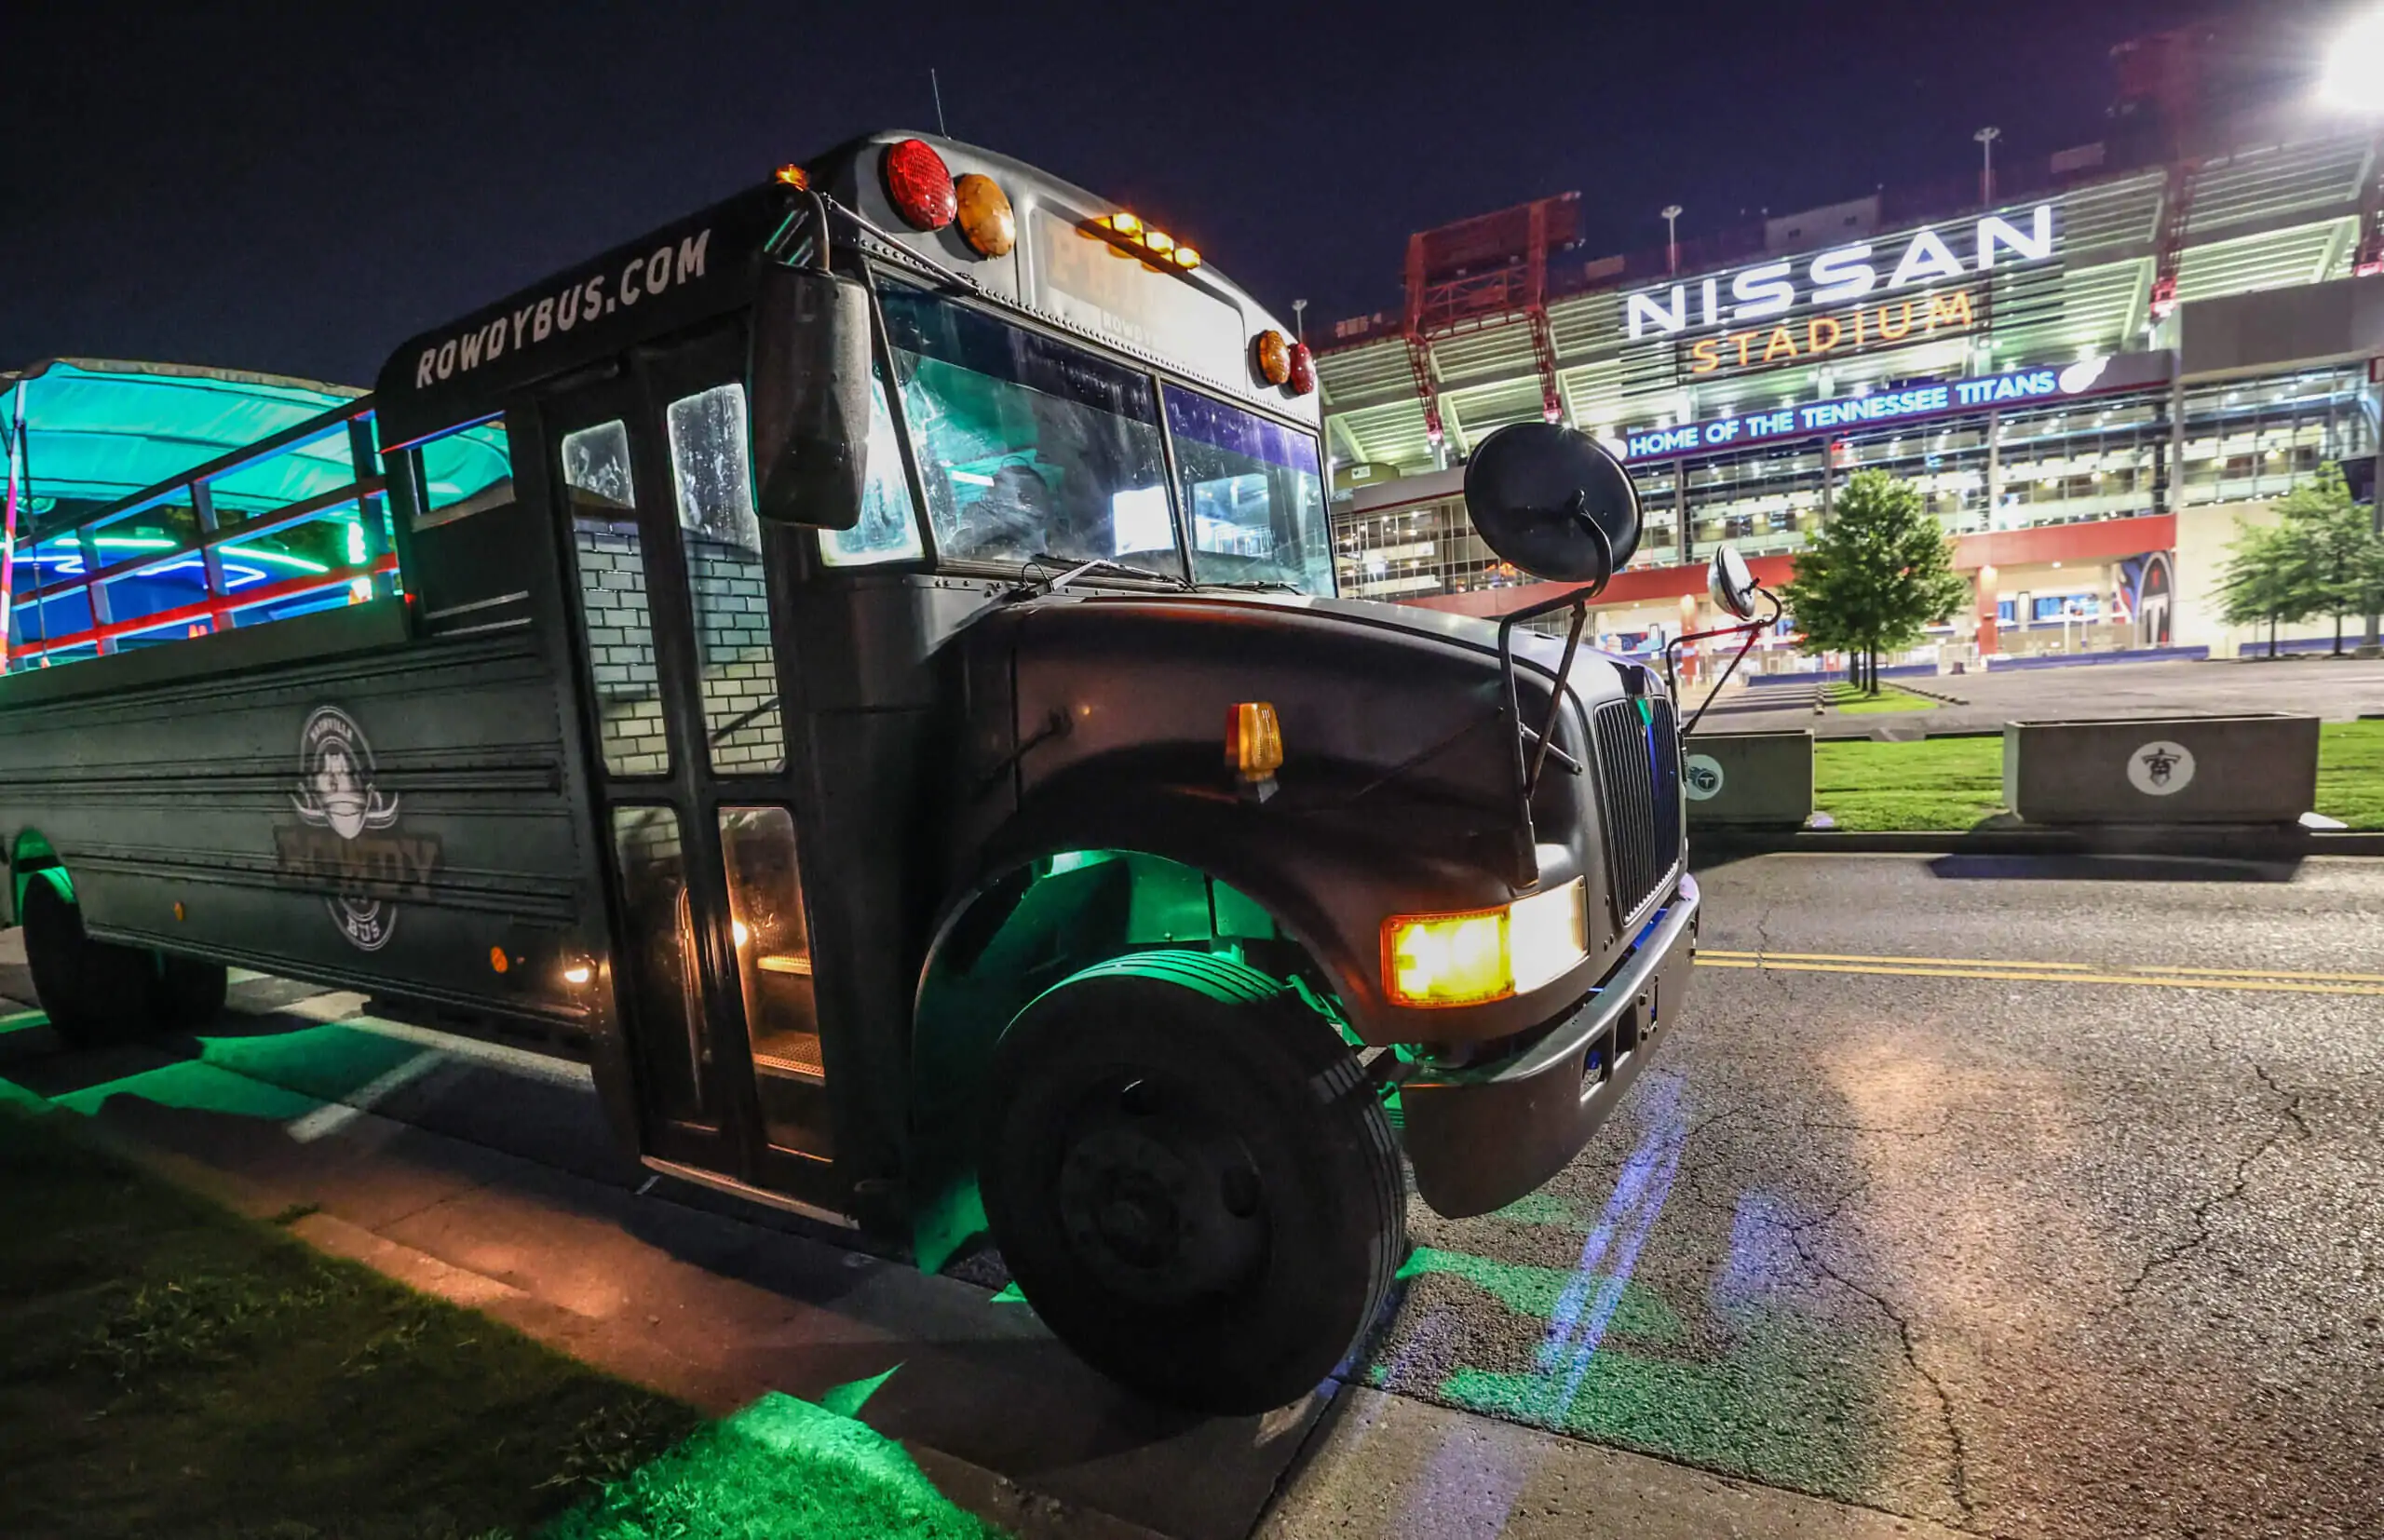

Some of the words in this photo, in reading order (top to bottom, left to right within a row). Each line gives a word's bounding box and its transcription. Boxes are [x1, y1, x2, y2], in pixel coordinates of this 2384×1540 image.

[415, 229, 711, 389] ROWDYBUS.COM
[1629, 205, 2052, 339] NISSAN
[1691, 290, 1972, 372] STADIUM
[1629, 426, 1700, 457] HOME
[1705, 417, 1740, 443] OF
[1745, 411, 1795, 437] THE
[1799, 387, 1948, 428] TENNESSEE
[1956, 370, 2055, 405] TITANS
